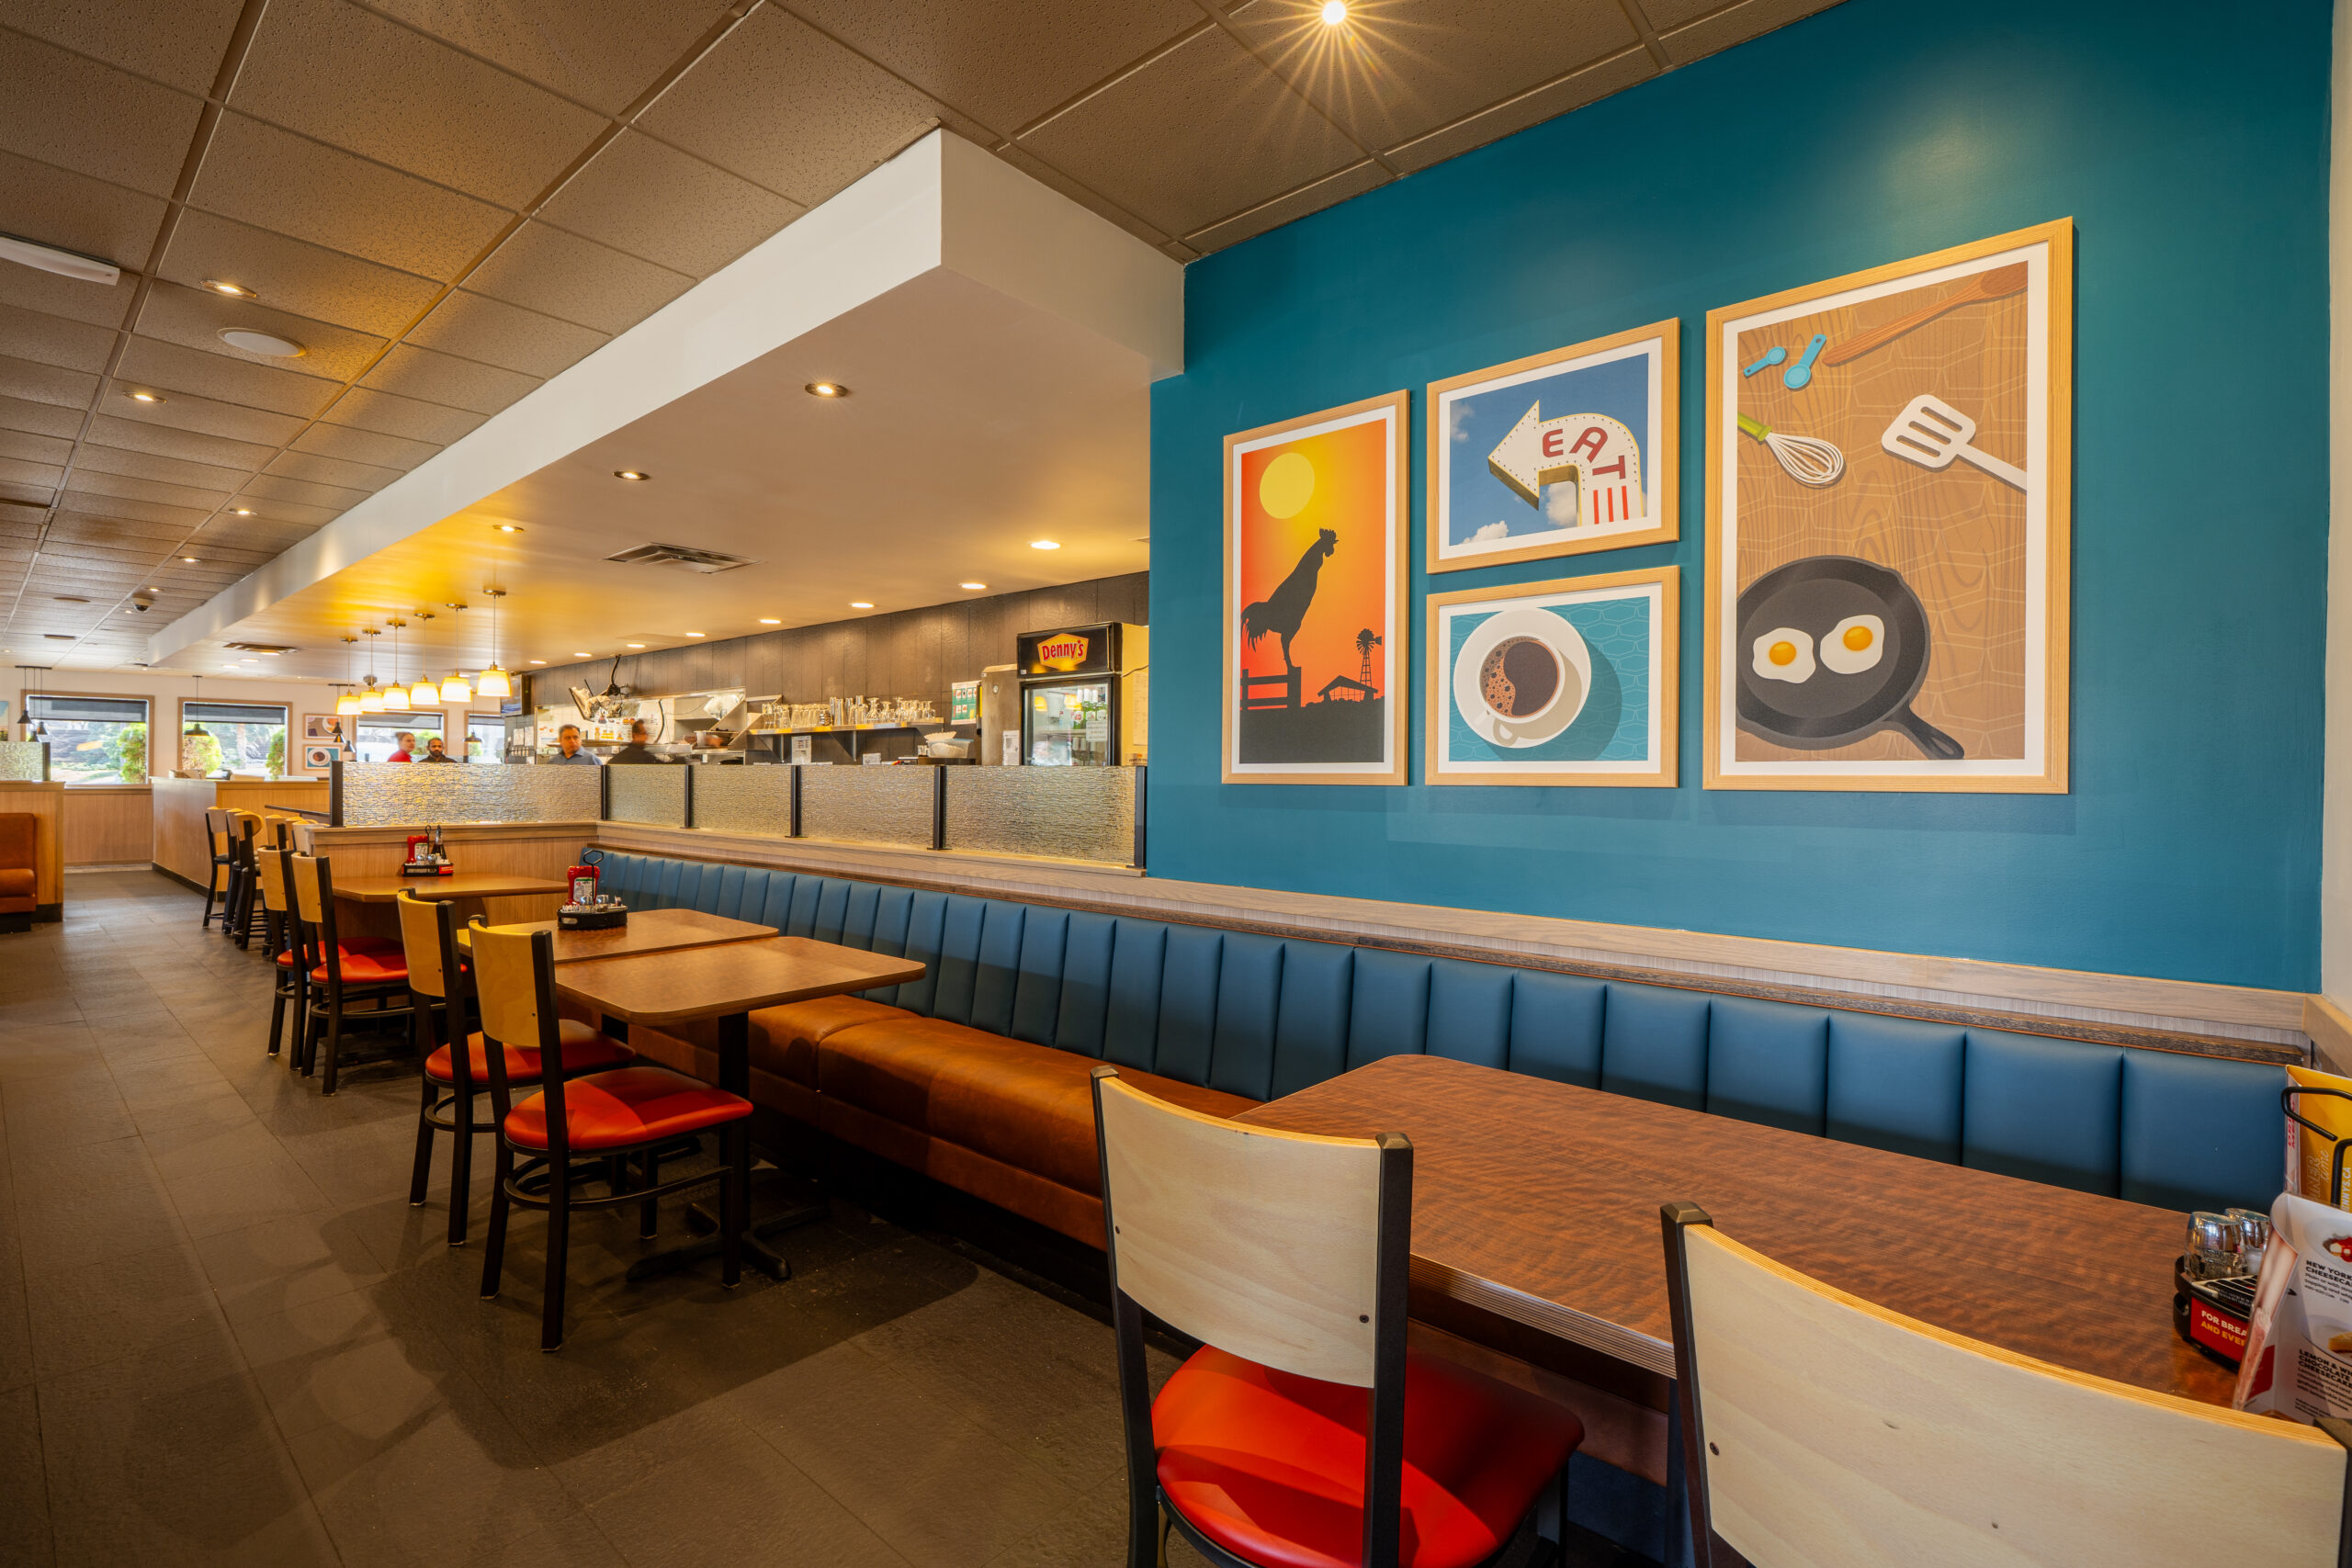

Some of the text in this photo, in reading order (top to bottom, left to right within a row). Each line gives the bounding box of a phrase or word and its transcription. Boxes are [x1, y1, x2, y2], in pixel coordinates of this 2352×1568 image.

[1542, 426, 1626, 480] EAT
[1041, 639, 1084, 661] Denny's
[2306, 1156, 2321, 1201] INER
[2341, 1168, 2351, 1212] ENNYS.CA
[2305, 1266, 2352, 1286] CHEESECA
[2306, 1259, 2325, 1270] NEW
[2200, 1321, 2221, 1335] AND
[2201, 1310, 2247, 1337] FOR BREA
[2299, 1348, 2330, 1365] LEMON
[2299, 1355, 2350, 1381] CHOCOLATE
